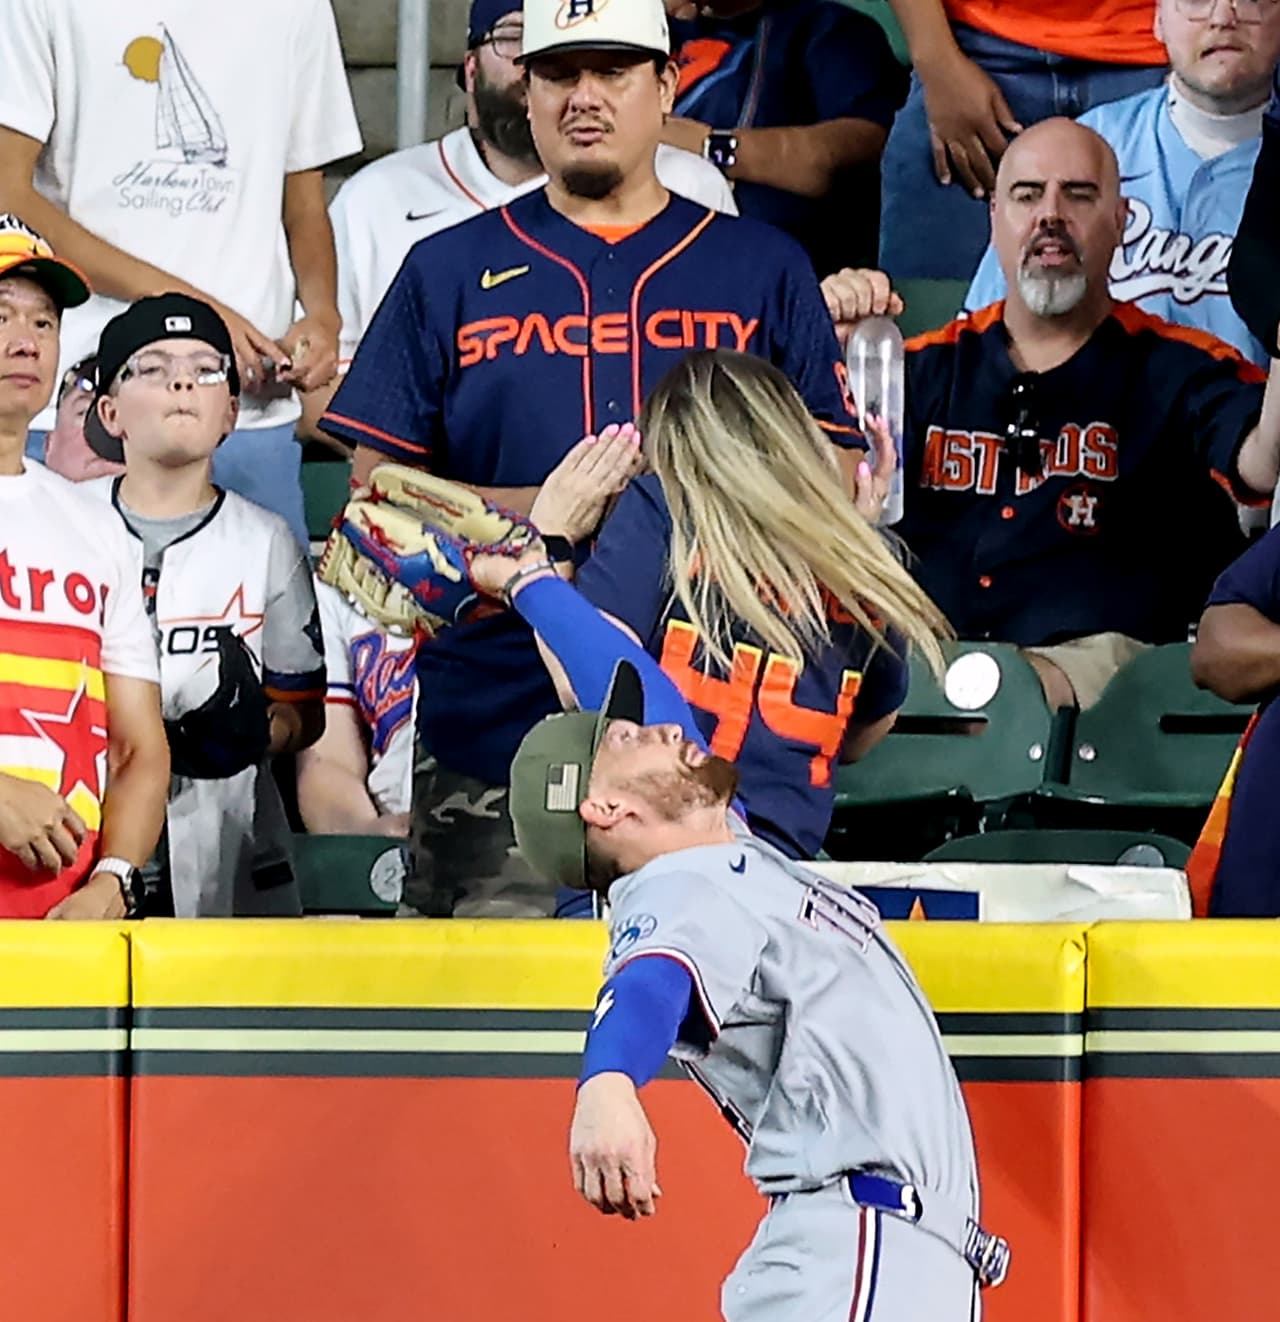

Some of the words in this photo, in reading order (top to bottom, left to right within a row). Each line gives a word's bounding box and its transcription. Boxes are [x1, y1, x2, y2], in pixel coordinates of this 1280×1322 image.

[118, 187, 184, 218] Sailing
[1107, 197, 1233, 304] Rang
[457, 311, 630, 368] SPACE
[645, 309, 759, 354] CITY
[660, 618, 863, 788] 44
